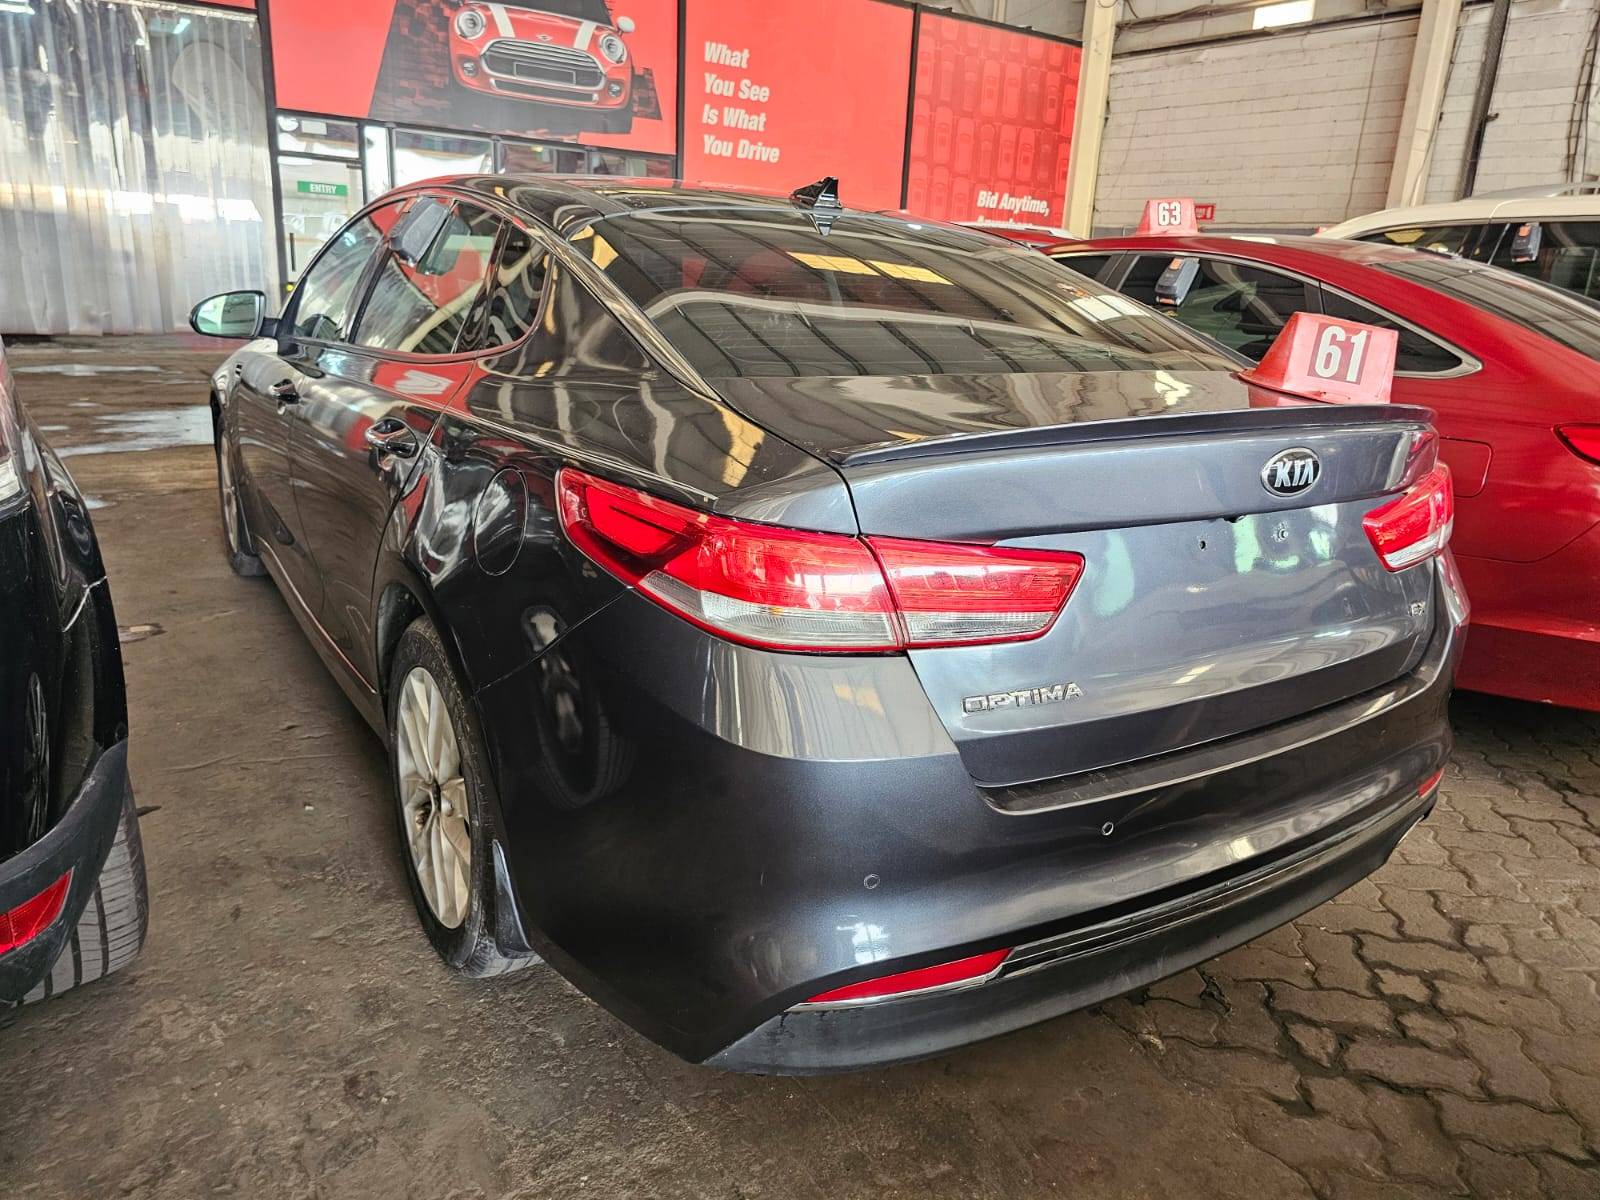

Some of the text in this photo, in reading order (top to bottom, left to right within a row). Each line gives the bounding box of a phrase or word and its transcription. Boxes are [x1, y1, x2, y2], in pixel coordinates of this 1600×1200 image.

[704, 41, 749, 69] What
[704, 72, 770, 102] You See
[702, 103, 767, 132] Is What
[703, 134, 780, 163] You Drive
[310, 183, 337, 195] ENTRY
[977, 190, 1050, 216] Bid Anytime,
[1158, 202, 1181, 226] 63
[1315, 325, 1368, 382] 61
[1273, 457, 1314, 488] KIA
[962, 682, 1084, 716] OPTIMA
